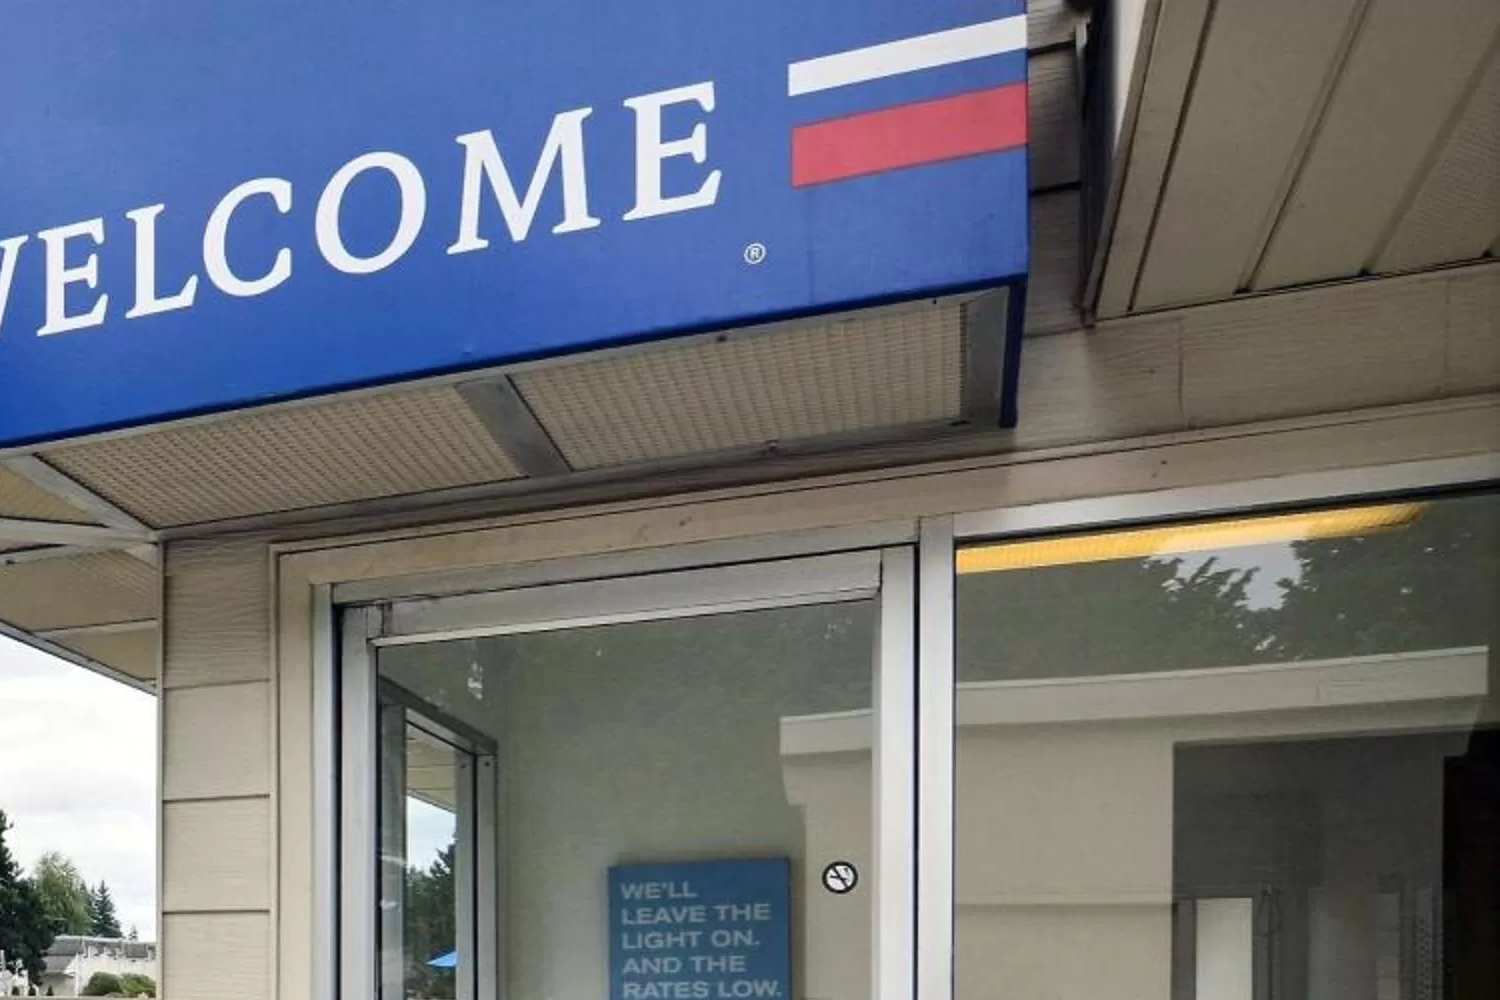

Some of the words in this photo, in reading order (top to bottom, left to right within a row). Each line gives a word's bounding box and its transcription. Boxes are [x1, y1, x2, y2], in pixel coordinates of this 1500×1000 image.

[620, 881, 698, 900] WE'LL
[620, 905, 708, 926] LEAVE
[713, 903, 772, 922] THE
[621, 930, 703, 951] LIGHT
[711, 929, 761, 948] ON.
[622, 956, 683, 974] AND
[689, 955, 747, 973] THE
[622, 981, 709, 999] RATES
[718, 979, 782, 998] LOW.
